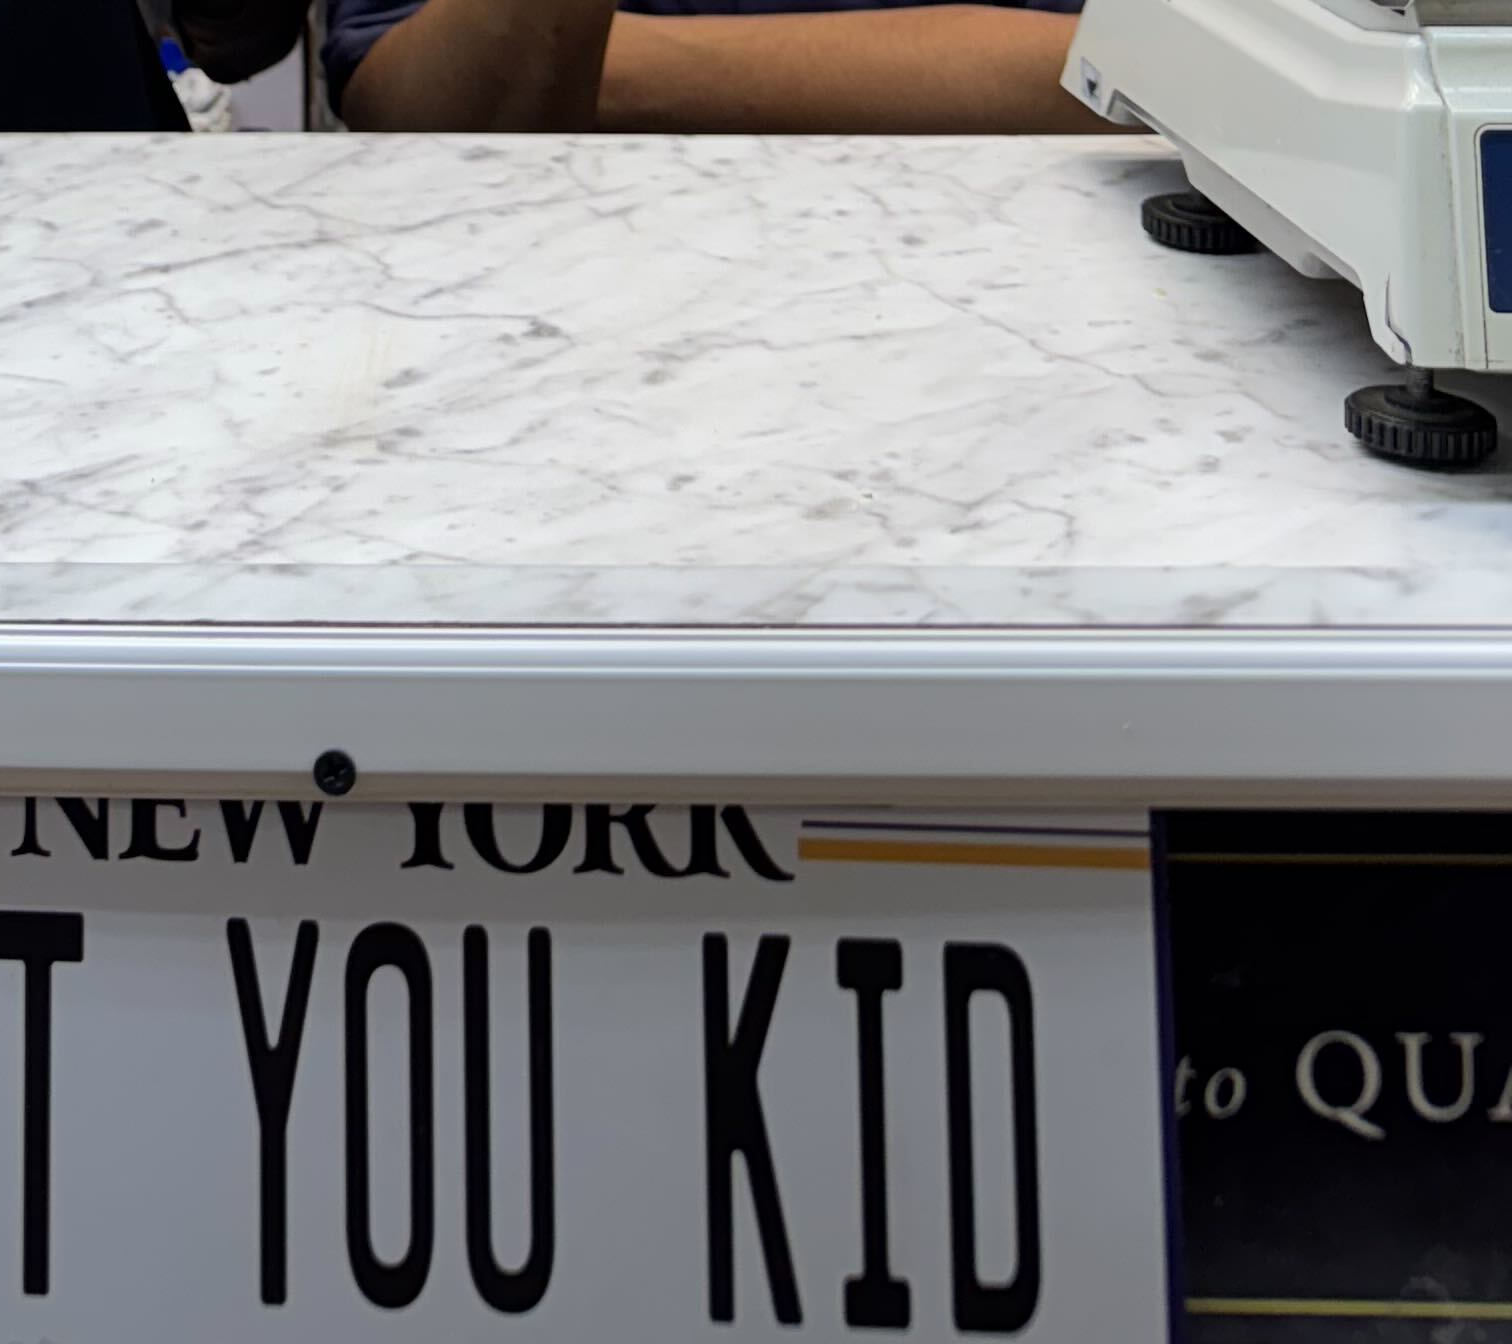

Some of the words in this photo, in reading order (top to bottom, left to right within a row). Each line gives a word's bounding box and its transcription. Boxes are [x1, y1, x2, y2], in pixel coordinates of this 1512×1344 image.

[225, 916, 556, 1315] YOU
[700, 930, 1043, 1334] KID
[1294, 1029, 1512, 1142] QU
